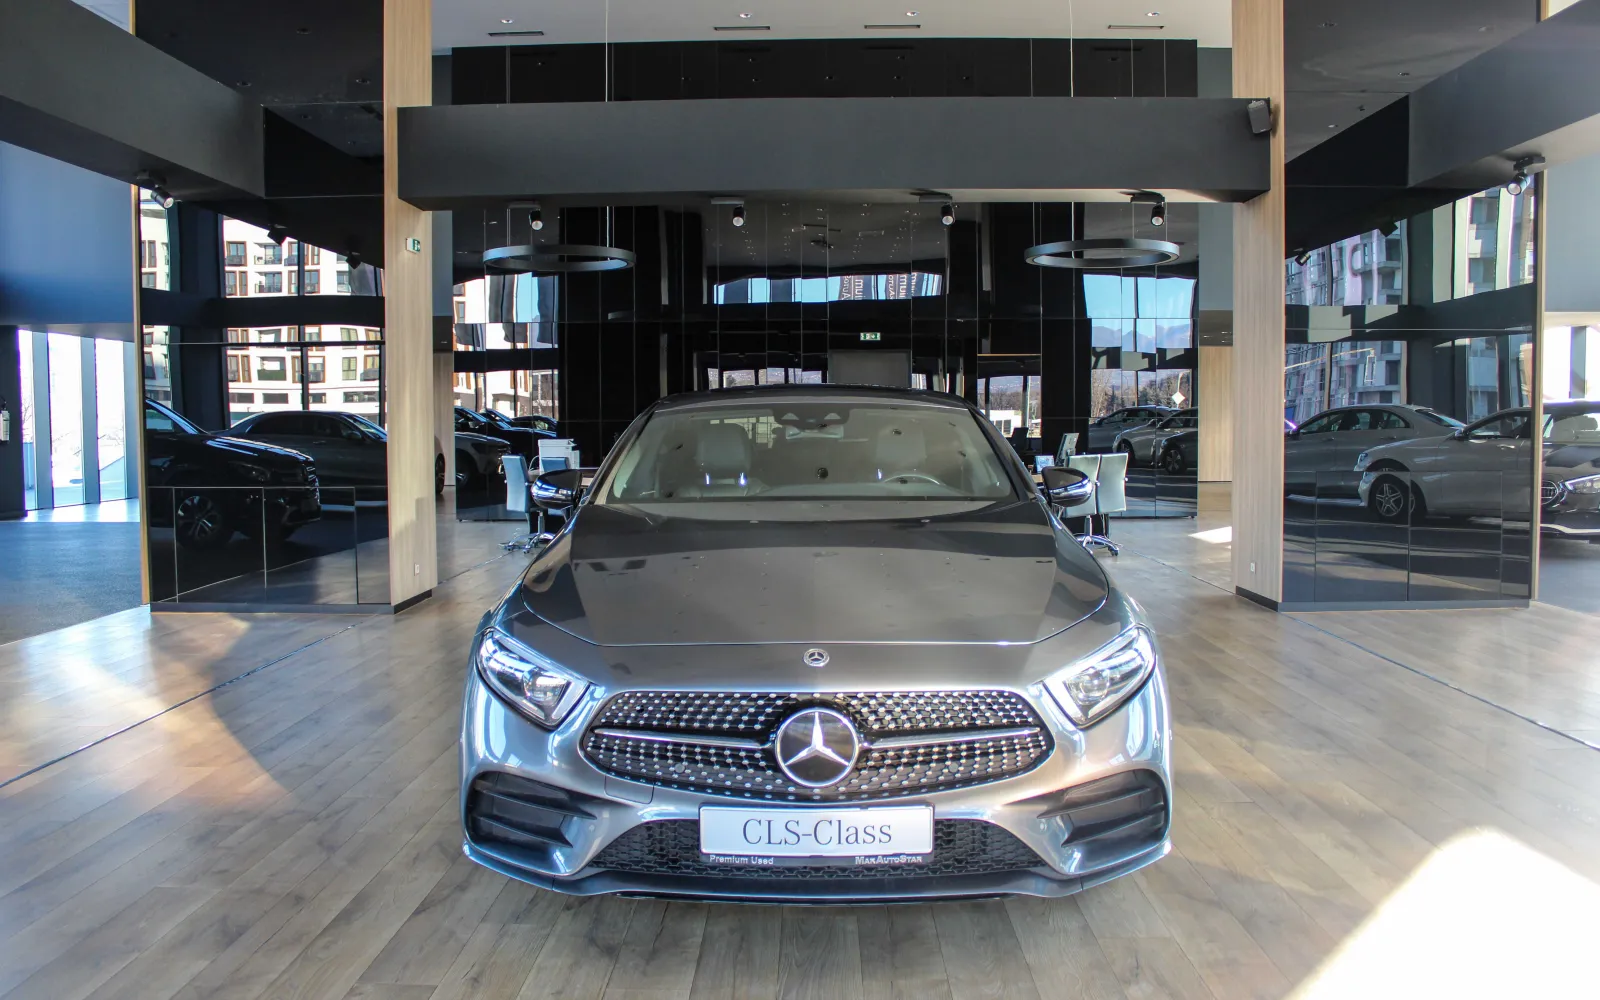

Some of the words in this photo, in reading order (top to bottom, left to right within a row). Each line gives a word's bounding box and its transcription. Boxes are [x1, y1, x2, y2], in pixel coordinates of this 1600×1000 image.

[742, 818, 892, 846] CLS-Class
[709, 854, 749, 865] Premium
[751, 856, 774, 865] Used
